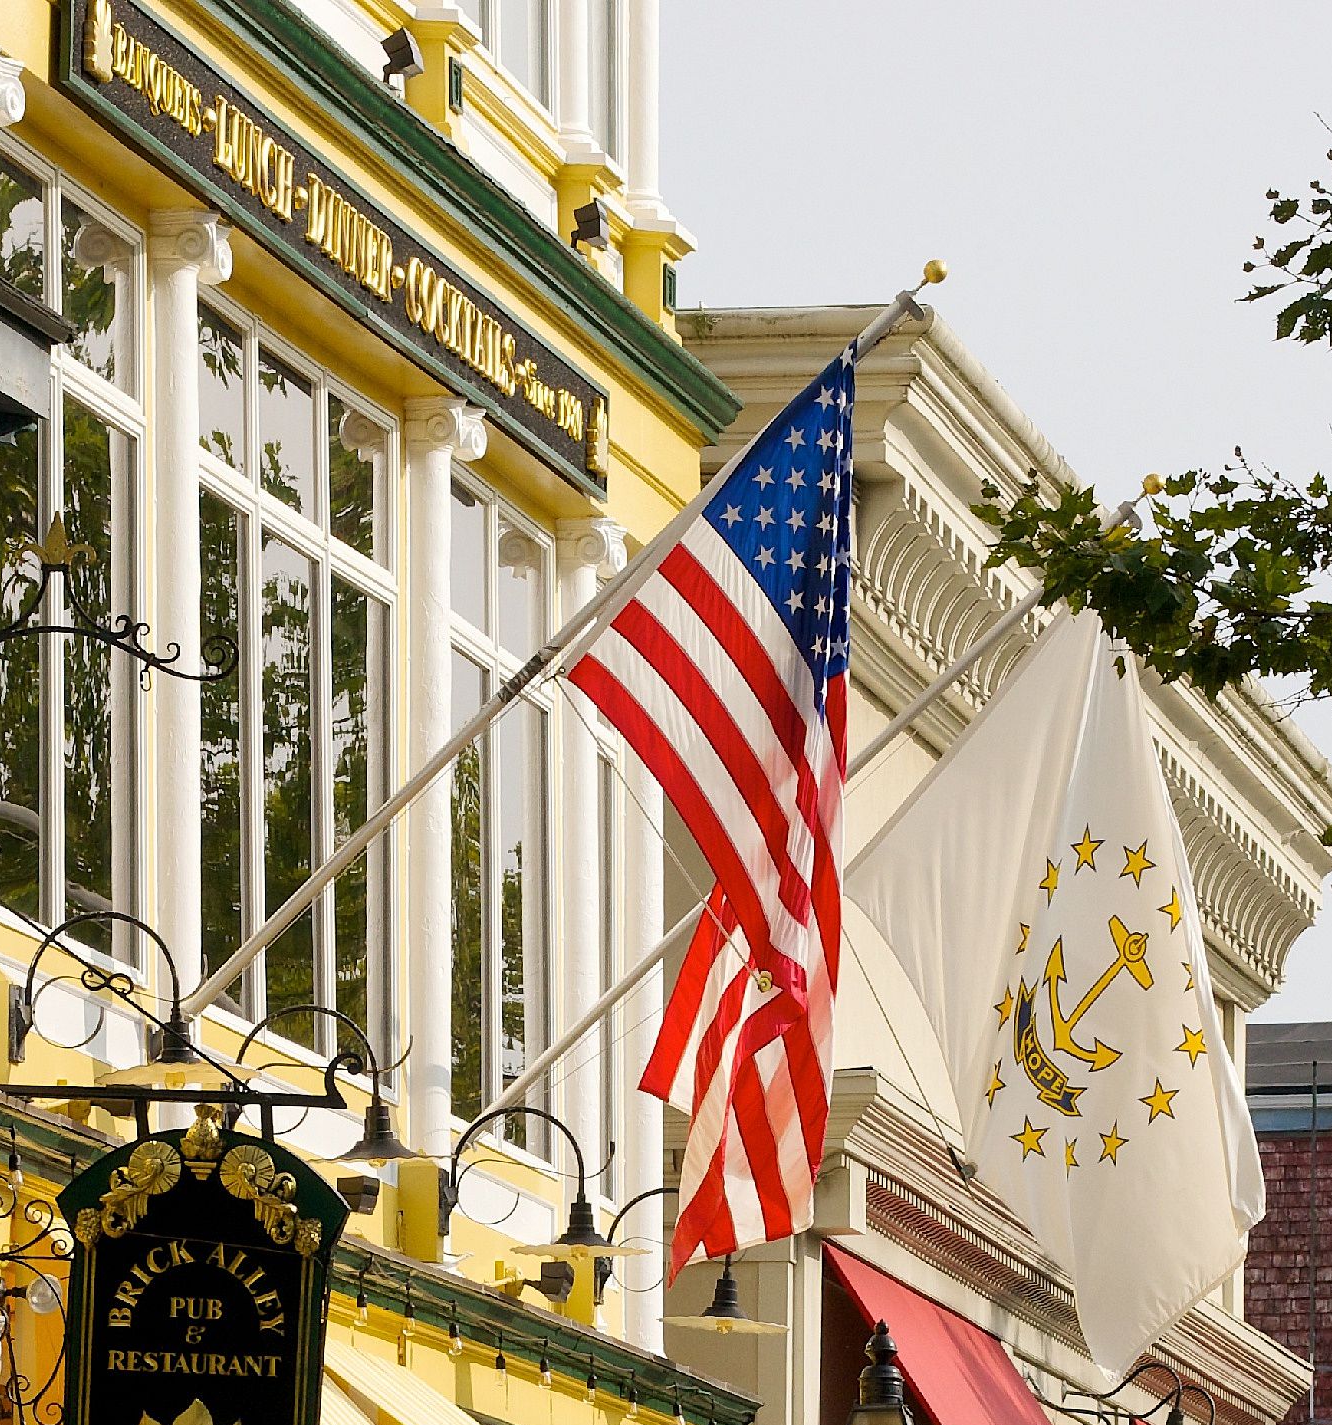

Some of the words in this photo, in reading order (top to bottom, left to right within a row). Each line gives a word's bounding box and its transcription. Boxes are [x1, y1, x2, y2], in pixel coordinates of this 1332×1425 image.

[112, 22, 202, 138] BANQUETS
[213, 94, 295, 223] LUNCH
[305, 172, 393, 303] DINNER
[405, 257, 516, 397] COCKTAILS
[1024, 1032, 1067, 1093] HOPE
[107, 1238, 195, 1328] BRICK
[206, 1241, 286, 1338] ALLEY
[168, 1297, 224, 1321] PUB
[185, 1325, 207, 1344] &
[107, 1349, 283, 1378] RESTAURANT
